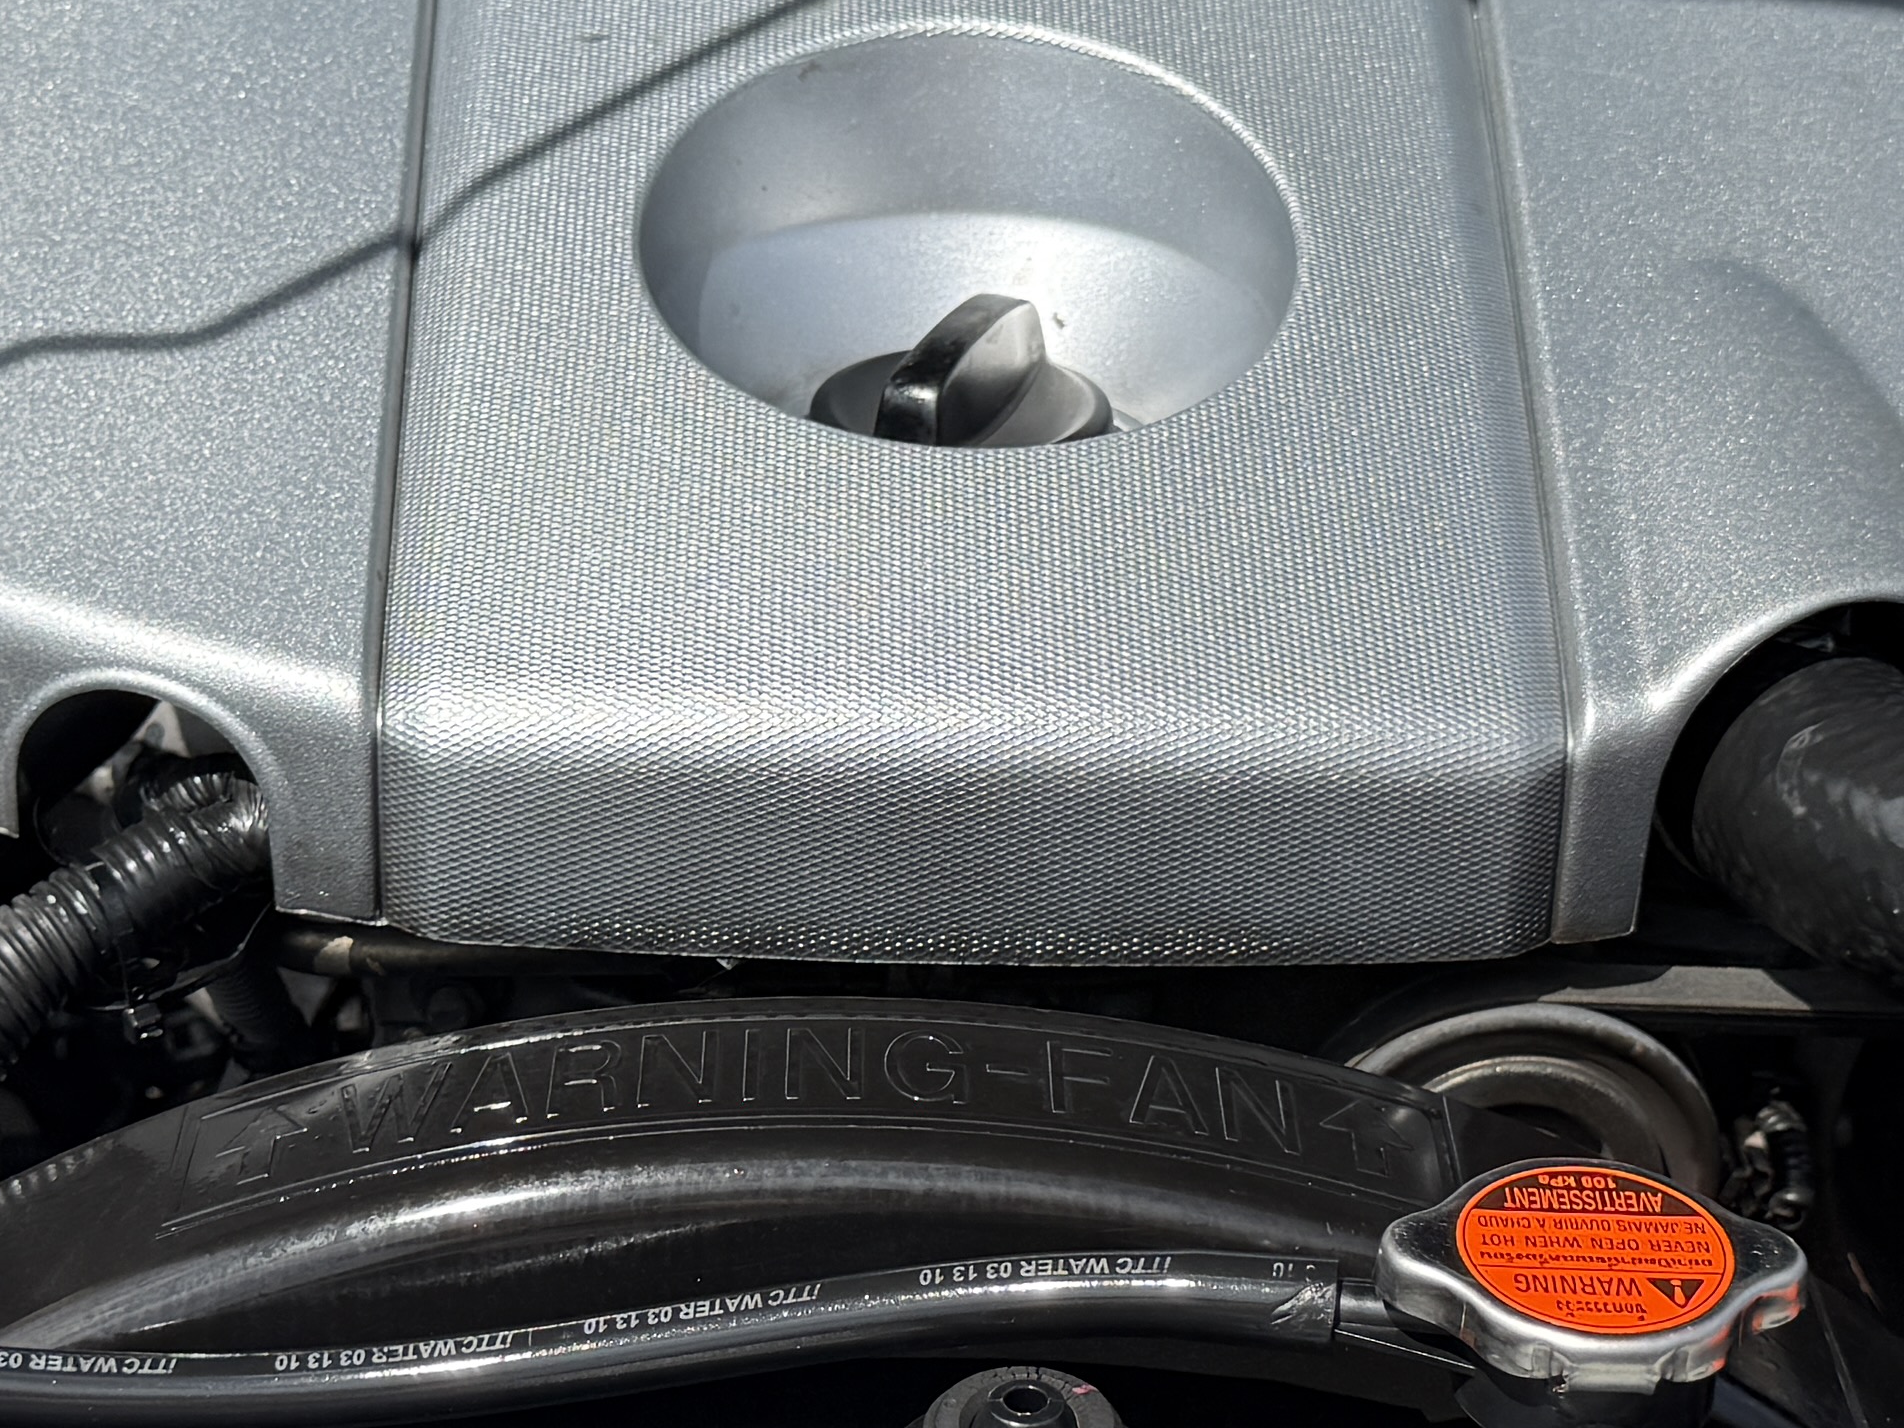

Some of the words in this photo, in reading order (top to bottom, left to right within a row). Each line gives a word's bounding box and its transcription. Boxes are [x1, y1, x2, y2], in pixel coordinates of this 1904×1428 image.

[338, 1027, 1303, 1156] WARNING-FAN
[1579, 1175, 1616, 1189] 100
[1503, 1187, 1664, 1213] AVERTISSEMENT
[1477, 1214, 1532, 1230] CHAUD
[1552, 1217, 1611, 1233] OUVRIR
[1615, 1218, 1680, 1234] JAMAIS
[1682, 1220, 1707, 1235] NE
[1479, 1232, 1516, 1247] HOT
[1525, 1234, 1582, 1249] WHEN
[1590, 1236, 1640, 1251] OPEN
[1648, 1239, 1711, 1254] NEVER
[918, 1268, 943, 1286] 10
[951, 1264, 978, 1284] 13
[985, 1261, 1012, 1280] 03
[1019, 1257, 1111, 1278] WATER
[1513, 1272, 1643, 1297] WARNING
[678, 1291, 764, 1321] WATER
[582, 1316, 609, 1335] 10
[615, 1311, 640, 1330] 13
[647, 1306, 674, 1326] 03
[306, 1350, 334, 1370] 13
[338, 1347, 367, 1367] 03
[370, 1337, 459, 1364] WATER
[29, 1351, 117, 1373] WATER
[274, 1352, 300, 1372] 10
